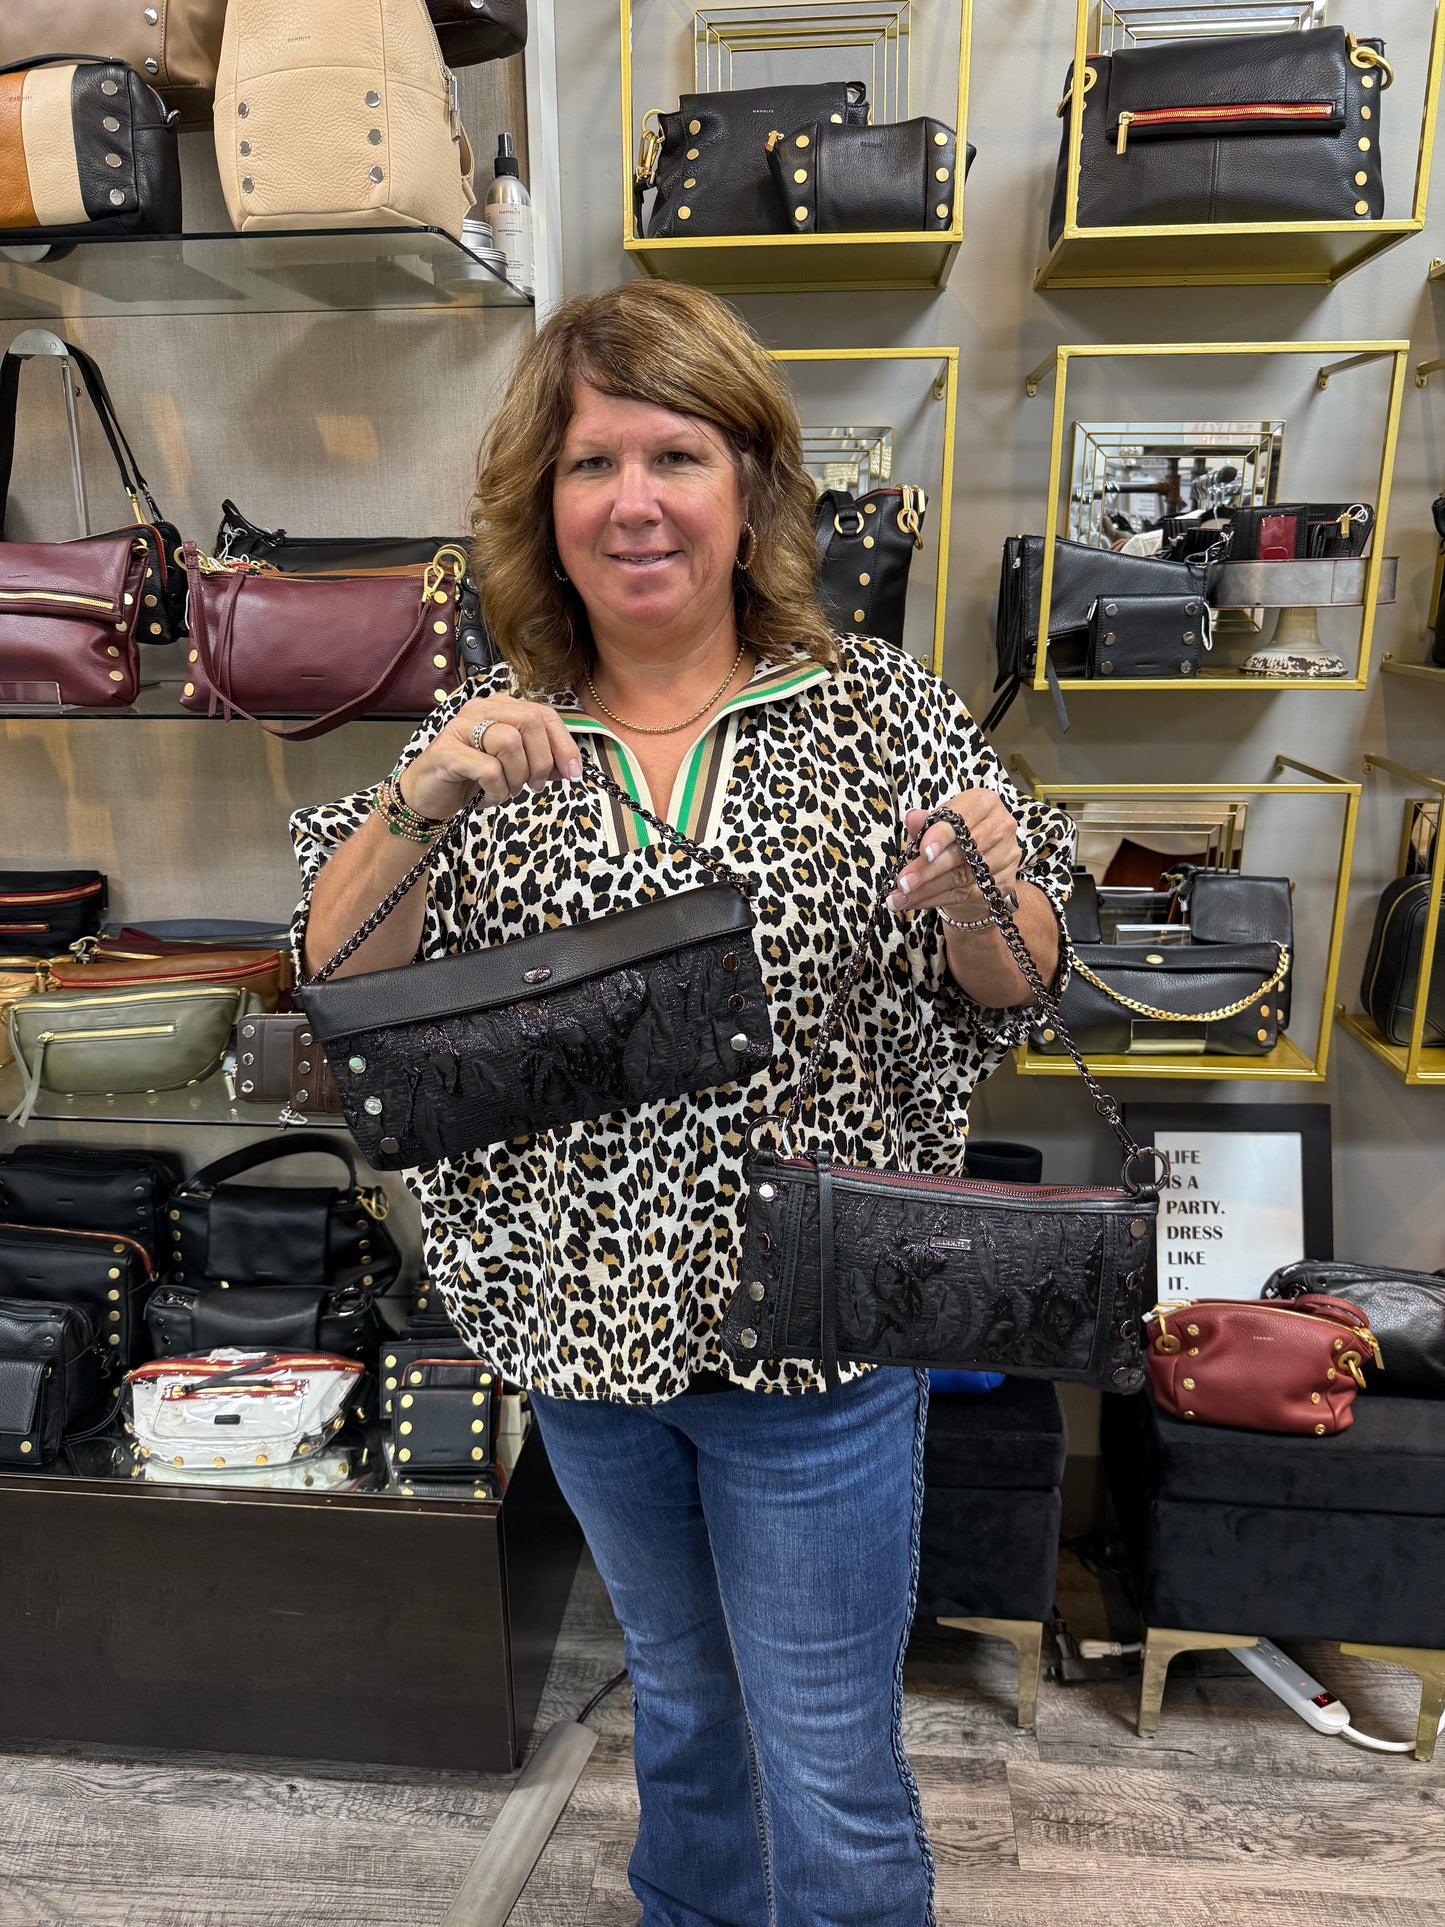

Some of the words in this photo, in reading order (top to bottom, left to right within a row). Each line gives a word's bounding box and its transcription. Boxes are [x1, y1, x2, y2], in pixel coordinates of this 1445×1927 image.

[1165, 1150, 1201, 1164] LIFE
[1165, 1175, 1182, 1190] IS
[1187, 1175, 1199, 1190] A
[1166, 1200, 1226, 1215] PARTY.
[1167, 1225, 1223, 1240] DRESS
[1167, 1251, 1207, 1265] LIKE
[1168, 1276, 1189, 1291] IT.
